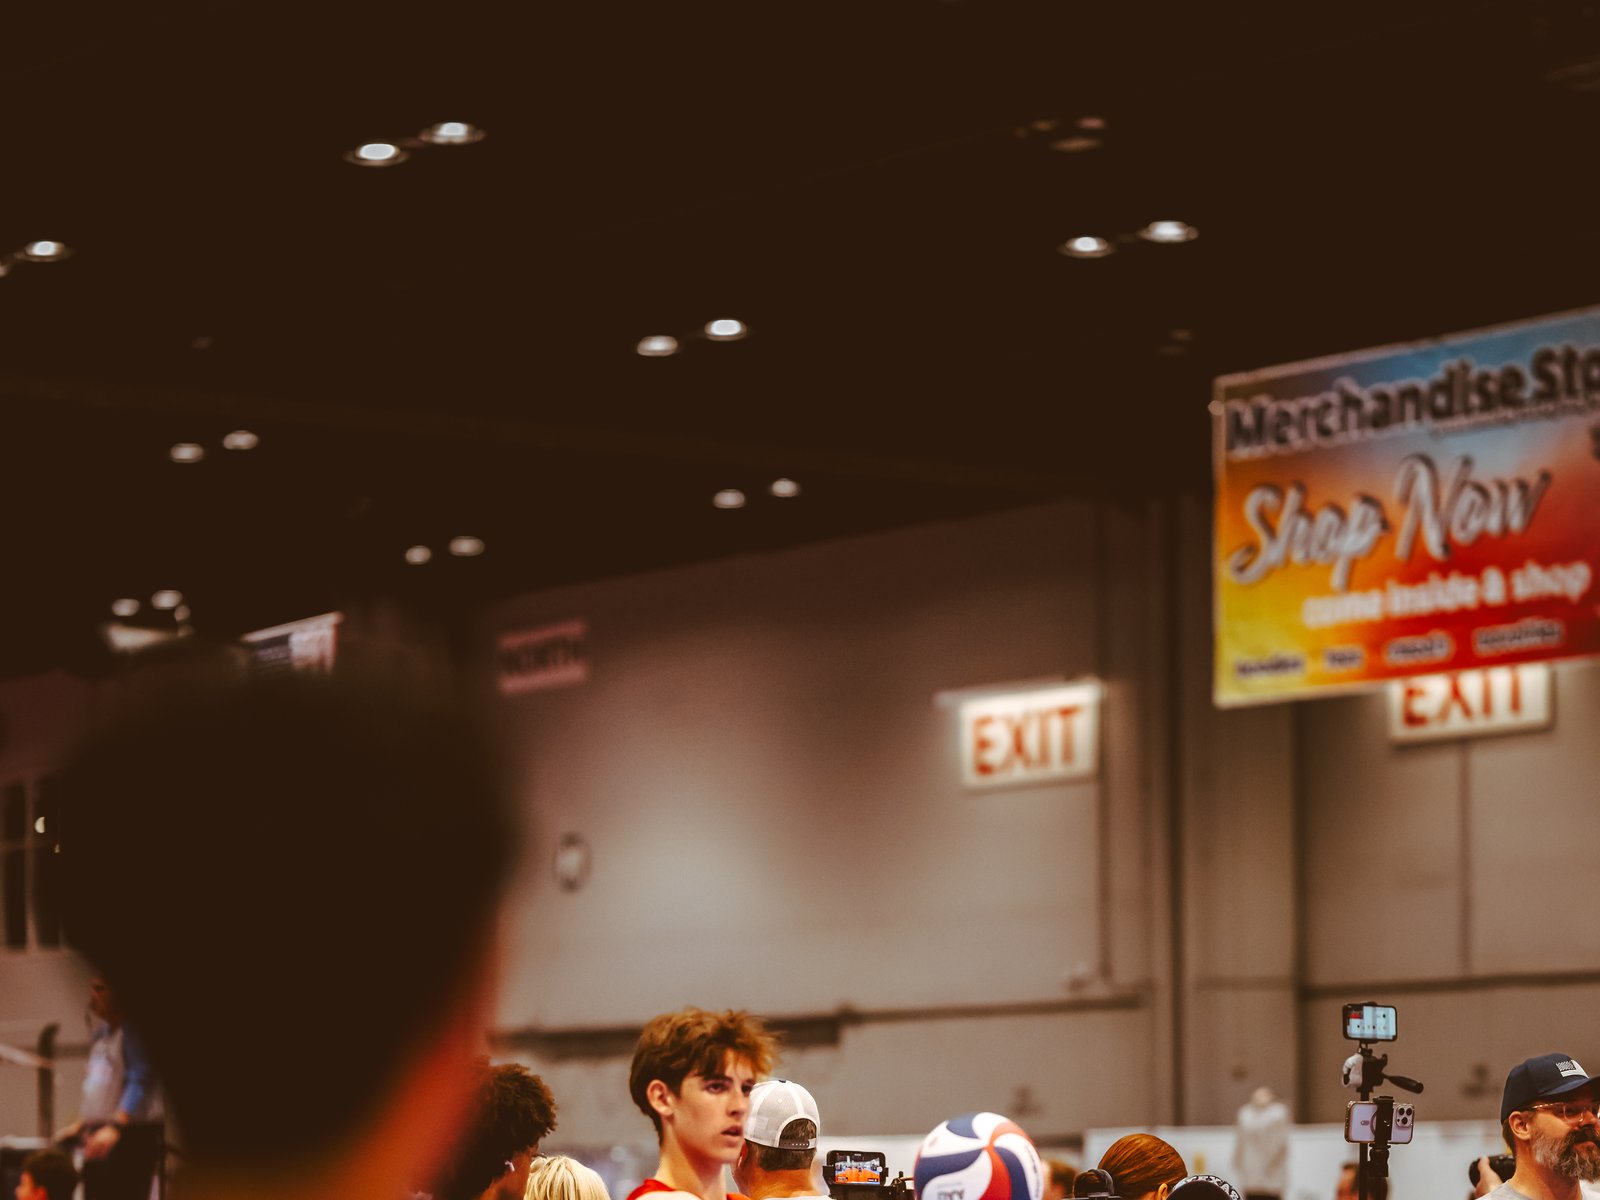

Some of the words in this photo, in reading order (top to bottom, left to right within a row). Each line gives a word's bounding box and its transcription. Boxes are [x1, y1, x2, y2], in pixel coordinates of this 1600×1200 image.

[1229, 482, 1390, 592] Shop
[1393, 453, 1552, 562] Now
[973, 704, 1084, 776] EXIT
